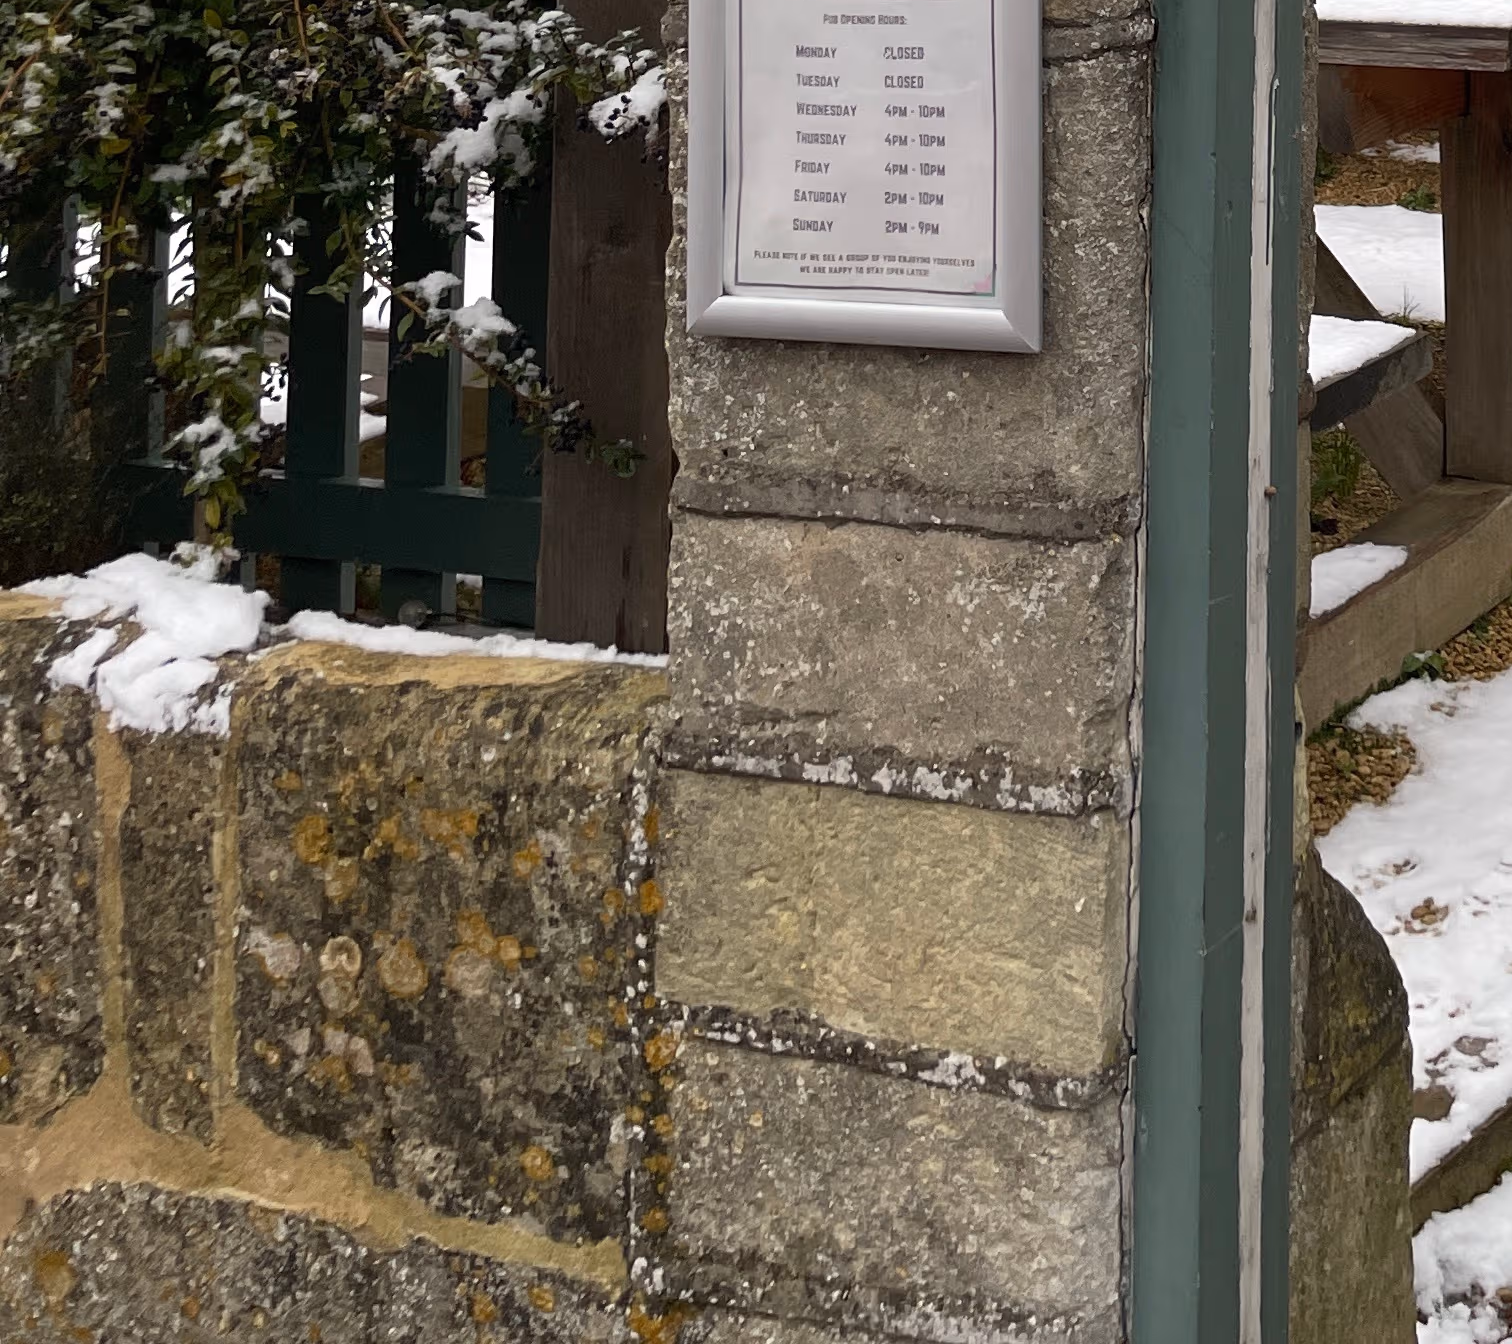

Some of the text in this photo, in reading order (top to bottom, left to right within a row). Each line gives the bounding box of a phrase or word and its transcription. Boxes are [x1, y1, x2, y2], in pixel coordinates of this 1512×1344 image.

[823, 14, 838, 25] PUB
[840, 14, 876, 25] OPENING
[796, 45, 925, 60] MONDAY CLOSED
[796, 74, 924, 89] TUESDAY CLOSED
[796, 102, 857, 117] WEDNESDAY
[884, 104, 908, 118] 4PM
[918, 105, 946, 118] 10PM
[796, 131, 846, 146] THURSDAY
[884, 133, 908, 146] 4PM
[918, 134, 946, 147] 10PM
[794, 159, 830, 174] FRIDAY
[884, 162, 908, 176] 4PM
[919, 162, 946, 176] 10PM
[794, 188, 847, 204] SATURDAY
[884, 192, 908, 205] 2PM
[918, 192, 944, 206] 10PM
[793, 218, 834, 232] SUNDAY
[885, 220, 908, 234] 2PM
[918, 221, 940, 235] 9PM
